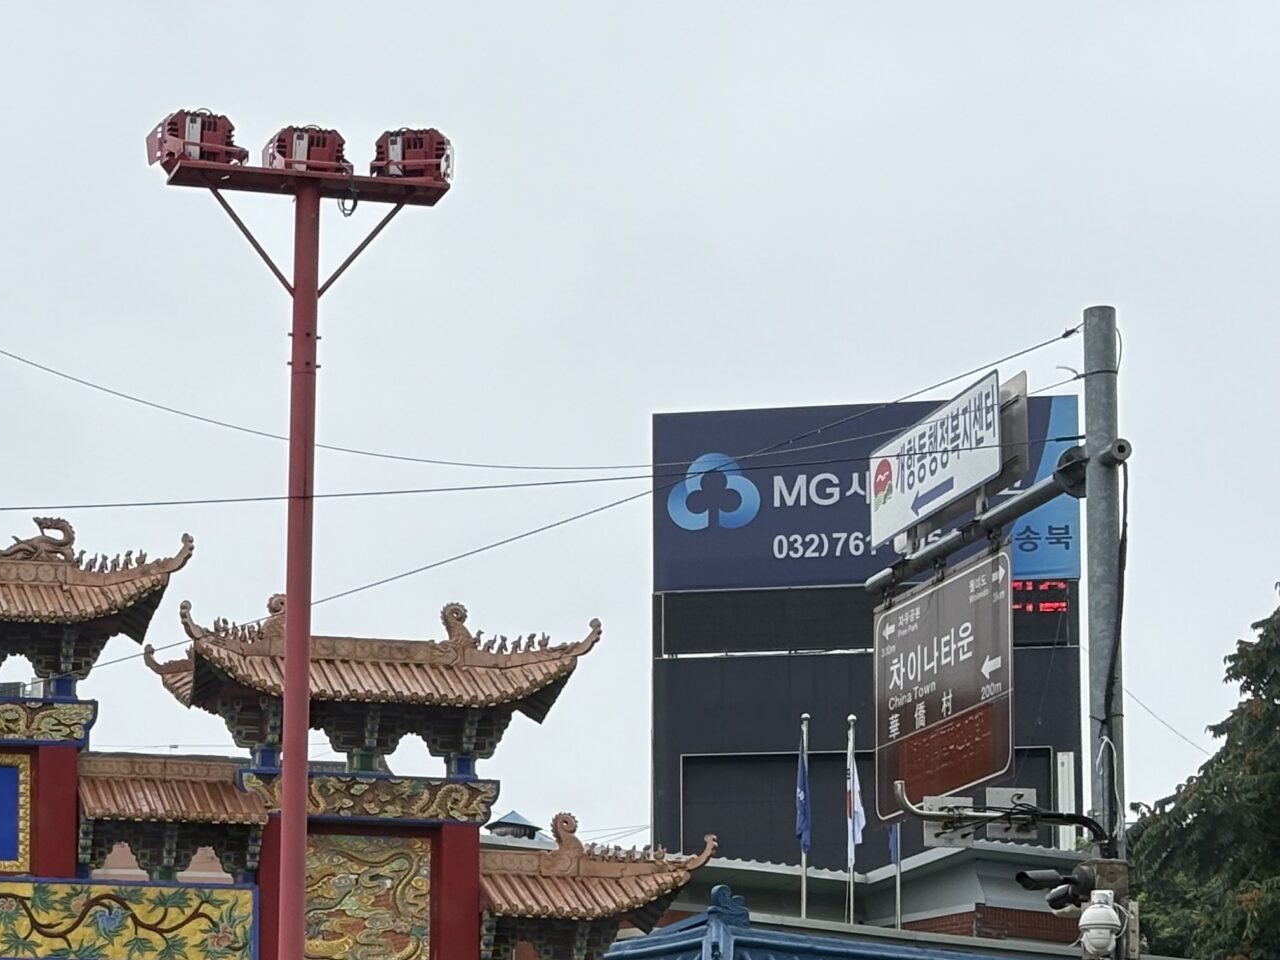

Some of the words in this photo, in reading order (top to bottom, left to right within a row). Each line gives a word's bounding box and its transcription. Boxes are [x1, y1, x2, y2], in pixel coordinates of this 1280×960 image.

[896, 384, 997, 494] 개항동행정복지센터
[888, 621, 974, 691] 차이나타운
[888, 692, 913, 711] China
[913, 681, 937, 700] Town
[980, 682, 1002, 700] 200m
